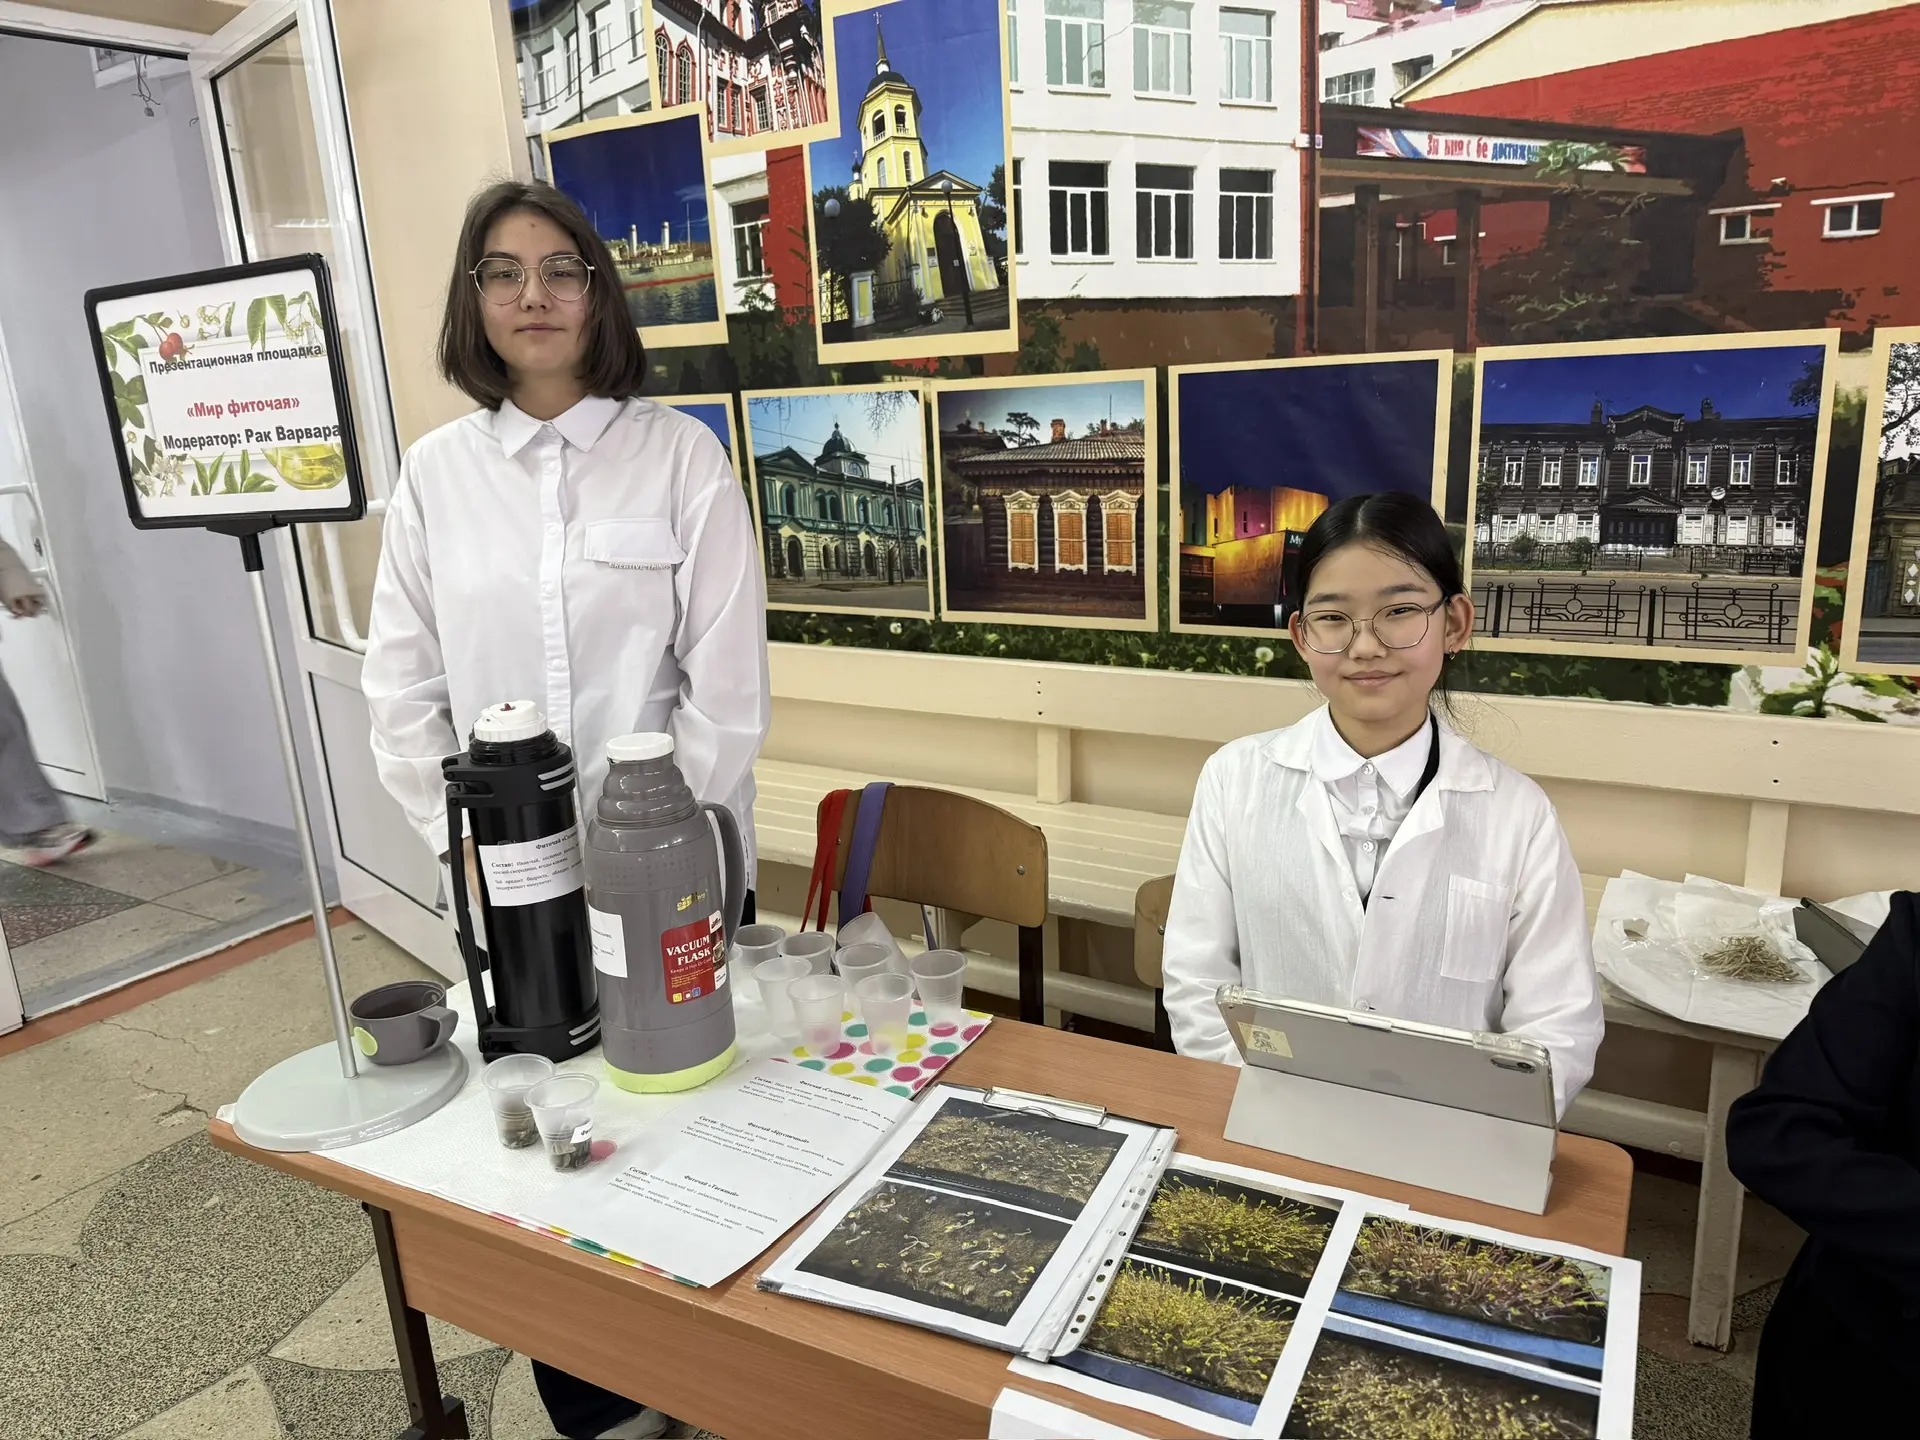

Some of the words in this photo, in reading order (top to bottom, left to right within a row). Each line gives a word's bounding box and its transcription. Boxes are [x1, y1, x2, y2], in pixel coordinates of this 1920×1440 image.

[149, 352, 253, 375] Презентационная
[257, 345, 322, 362] площадка
[187, 401, 223, 419] «Мир
[228, 396, 300, 417] фиточая»
[163, 431, 242, 451] Модератор:
[246, 427, 272, 443] Рак
[275, 424, 340, 443] Варвара
[491, 861, 514, 869] Состав:
[666, 935, 710, 956] VACUUM
[677, 947, 711, 966] FLASK
